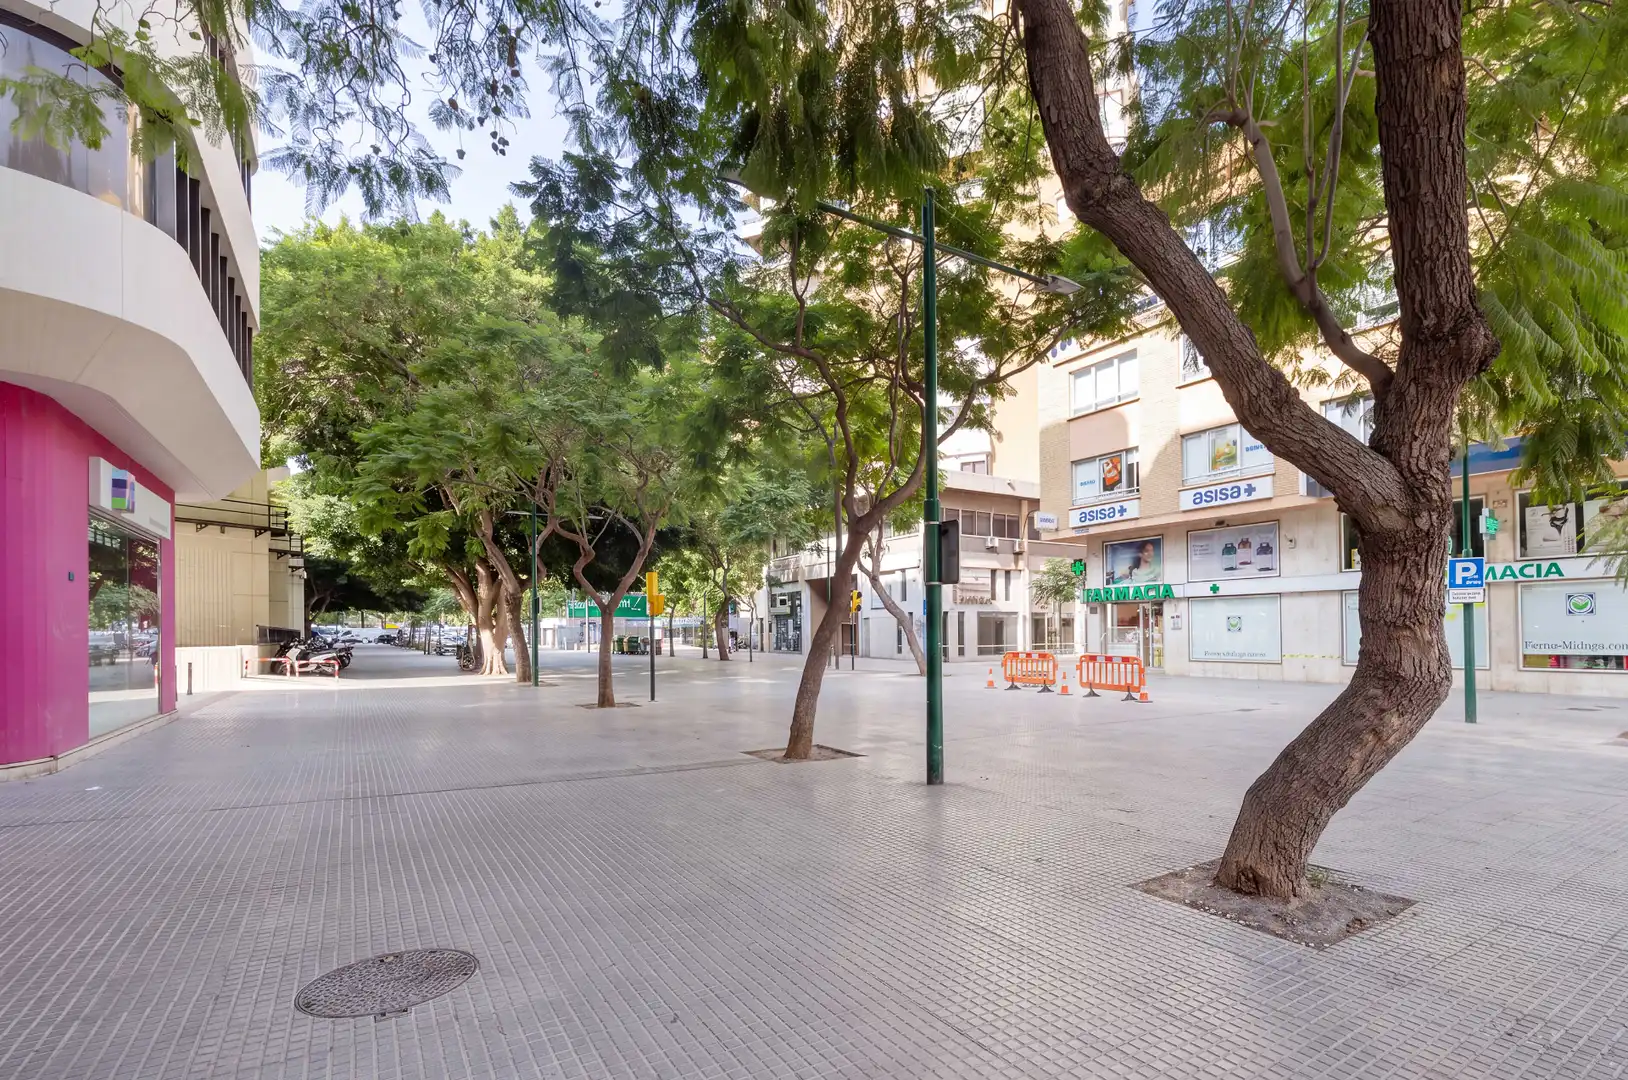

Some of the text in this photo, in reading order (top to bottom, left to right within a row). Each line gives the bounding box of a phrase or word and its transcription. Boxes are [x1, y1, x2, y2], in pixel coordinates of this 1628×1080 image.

[1193, 485, 1241, 505] asisa
[1079, 506, 1116, 523] asisa
[1455, 562, 1477, 585] P
[1485, 562, 1565, 581] MACIA
[1083, 584, 1175, 603] FARMACIA
